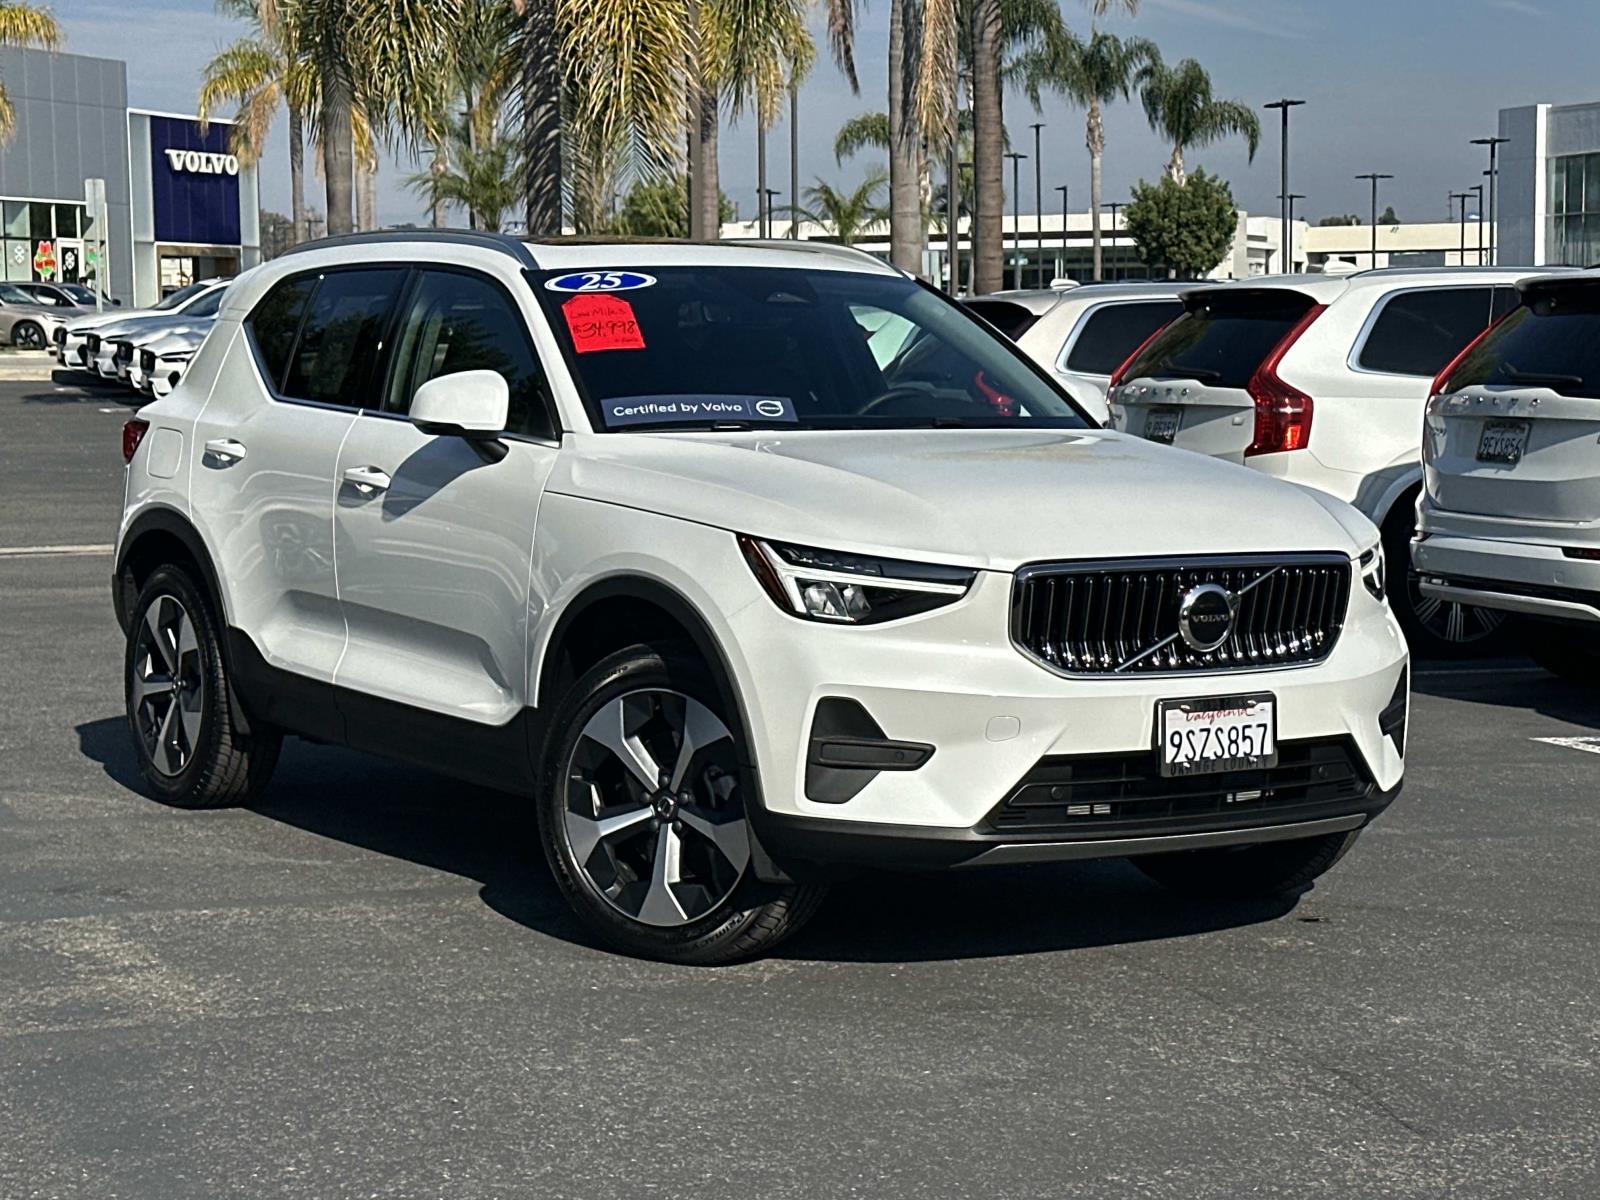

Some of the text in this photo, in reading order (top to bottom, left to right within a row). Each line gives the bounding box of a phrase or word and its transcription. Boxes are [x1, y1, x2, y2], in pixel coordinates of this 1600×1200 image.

[165, 149, 239, 175] VOLVO
[579, 273, 624, 290] 25
[613, 402, 743, 416] Certified by Volvo
[1191, 614, 1229, 623] VOLVO
[1170, 723, 1268, 763] 9SZS857
